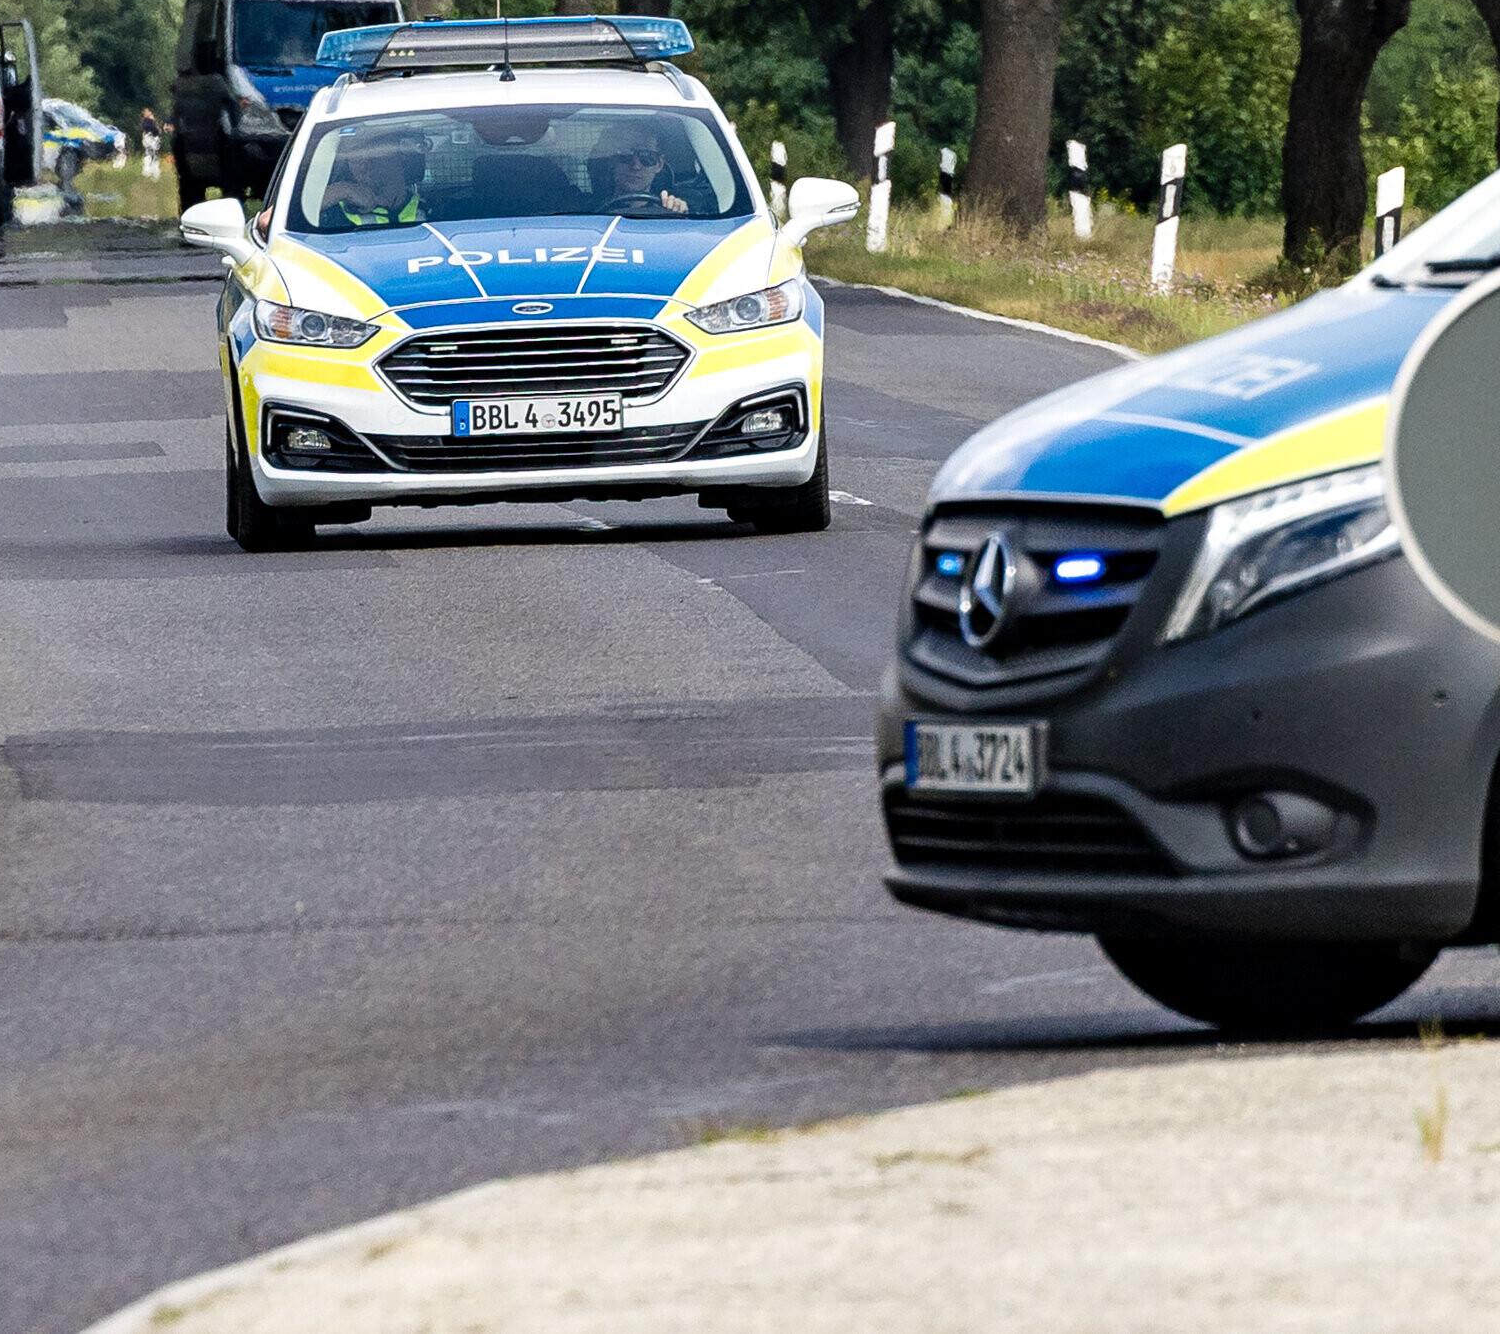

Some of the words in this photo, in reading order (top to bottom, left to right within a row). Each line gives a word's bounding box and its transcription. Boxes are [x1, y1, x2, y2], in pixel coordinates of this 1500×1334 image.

[407, 246, 645, 274] POLIZEI
[472, 404, 518, 430] BBL
[525, 403, 539, 428] 4
[557, 399, 616, 427] 3495
